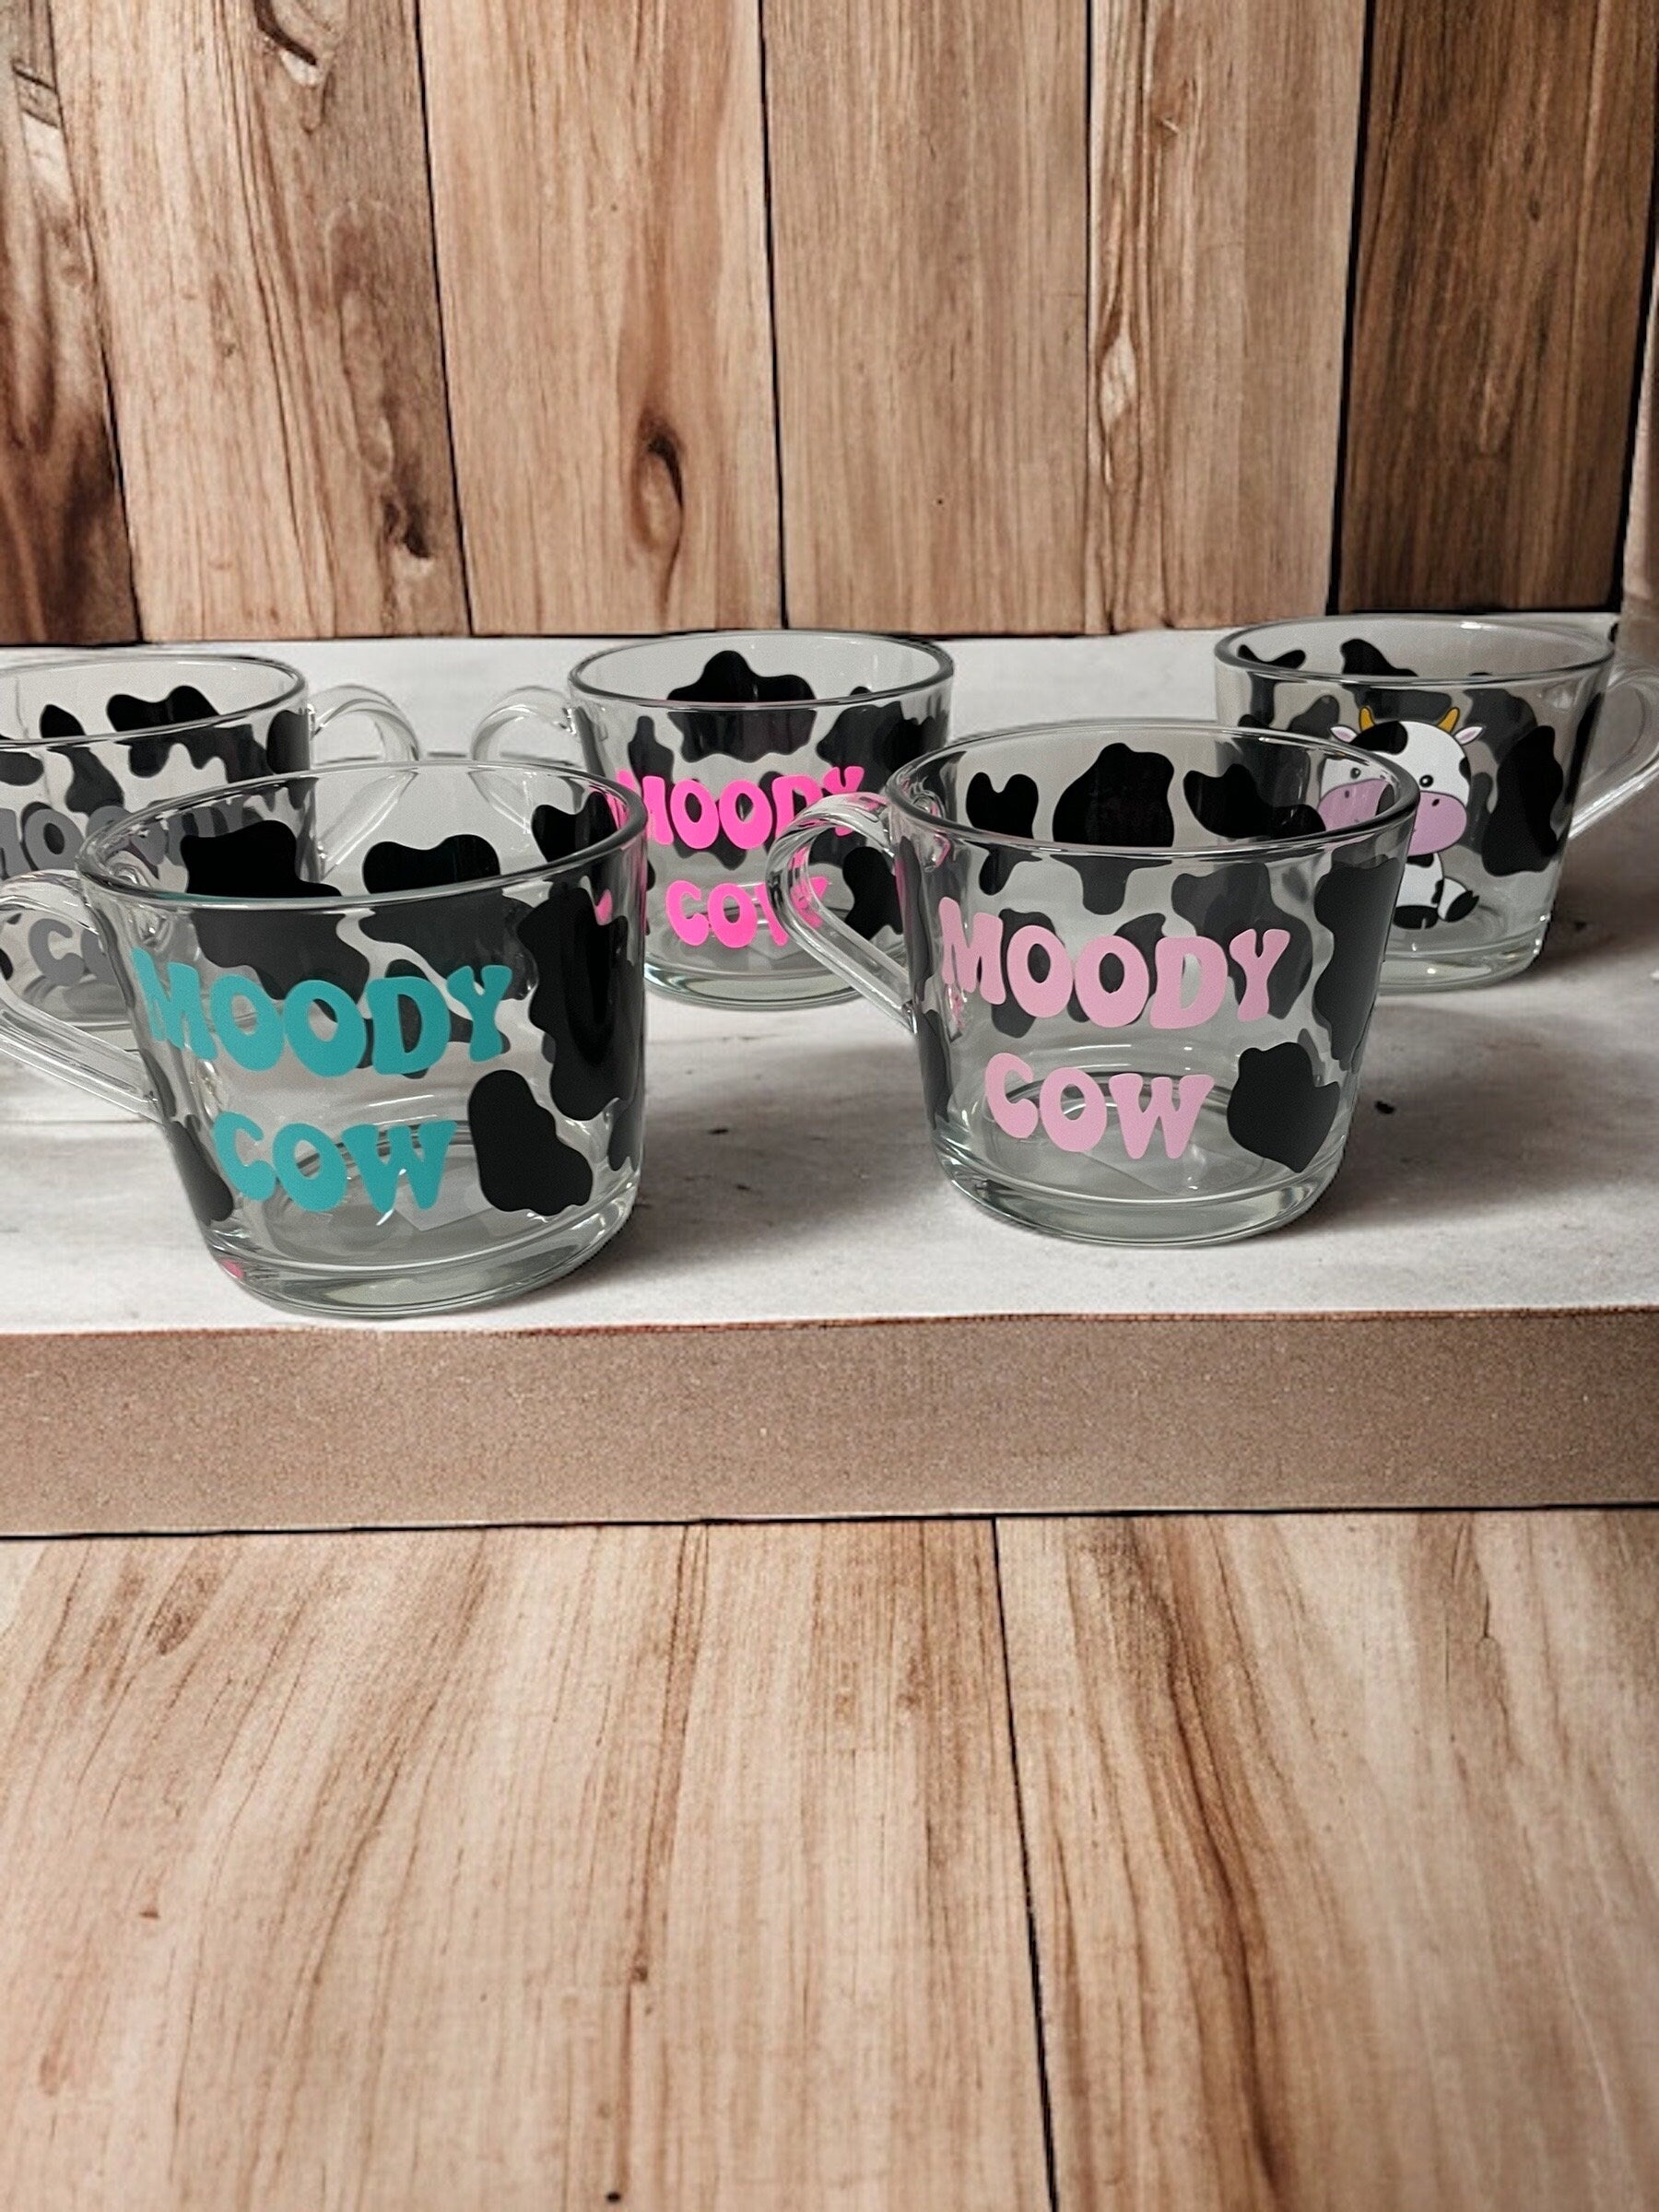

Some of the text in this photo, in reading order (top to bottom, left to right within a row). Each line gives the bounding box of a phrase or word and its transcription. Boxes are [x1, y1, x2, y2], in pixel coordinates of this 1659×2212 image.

[132, 947, 512, 1077] MOODY
[938, 897, 1290, 1030] MOODY
[213, 1112, 458, 1214] COW
[984, 1053, 1214, 1159] COW
